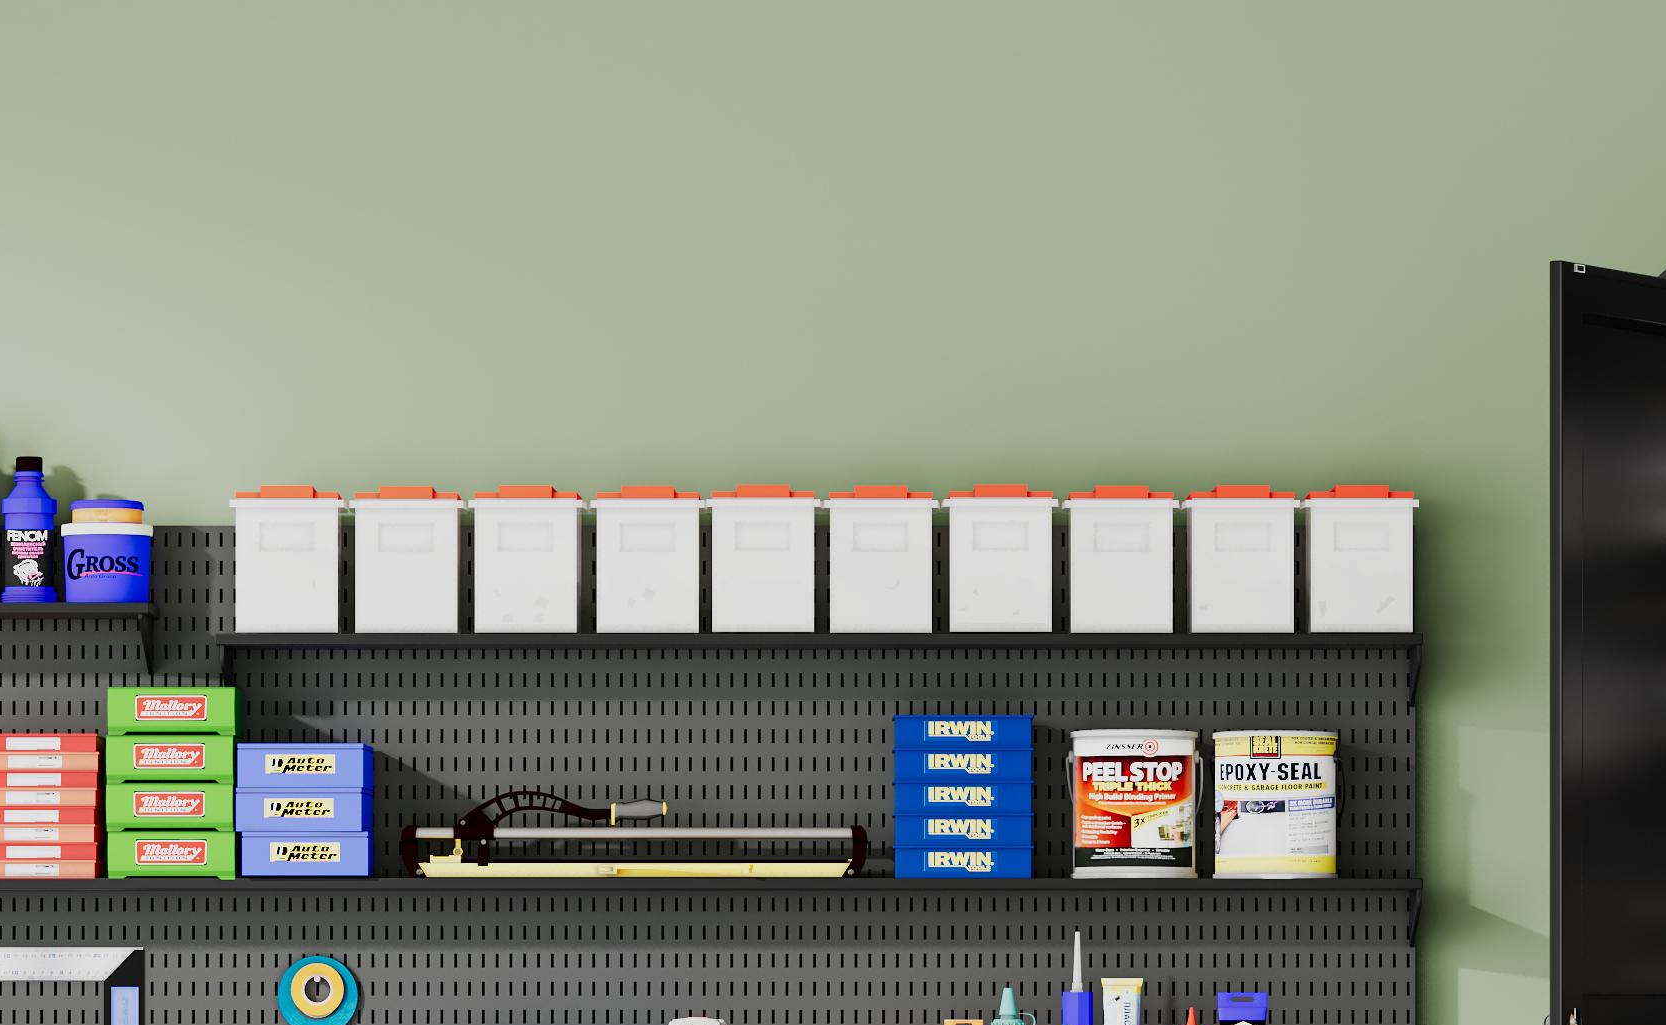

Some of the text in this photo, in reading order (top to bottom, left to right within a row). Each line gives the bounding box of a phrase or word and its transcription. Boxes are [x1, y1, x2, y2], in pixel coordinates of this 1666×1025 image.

[6, 529, 49, 542] FENOM
[67, 548, 140, 581] GROSS
[142, 699, 202, 712] Mallory
[928, 721, 992, 736] IRWIN
[140, 747, 200, 760] Mallory
[928, 754, 992, 768] IRWIN
[282, 764, 333, 773] Meter
[1082, 761, 1183, 782] PEEL STOP
[1220, 762, 1322, 781] EPOXY-SEAL
[1092, 781, 1173, 792] TRIPLE THICK
[1281, 783, 1303, 791] FLOOR
[928, 787, 992, 801] IRWIN
[140, 795, 200, 808] Mallory
[280, 808, 331, 817] Meter
[928, 819, 992, 834] IRWIN
[142, 843, 202, 856] Mallory
[286, 852, 337, 861] Meter
[928, 852, 992, 866] IRWIN
